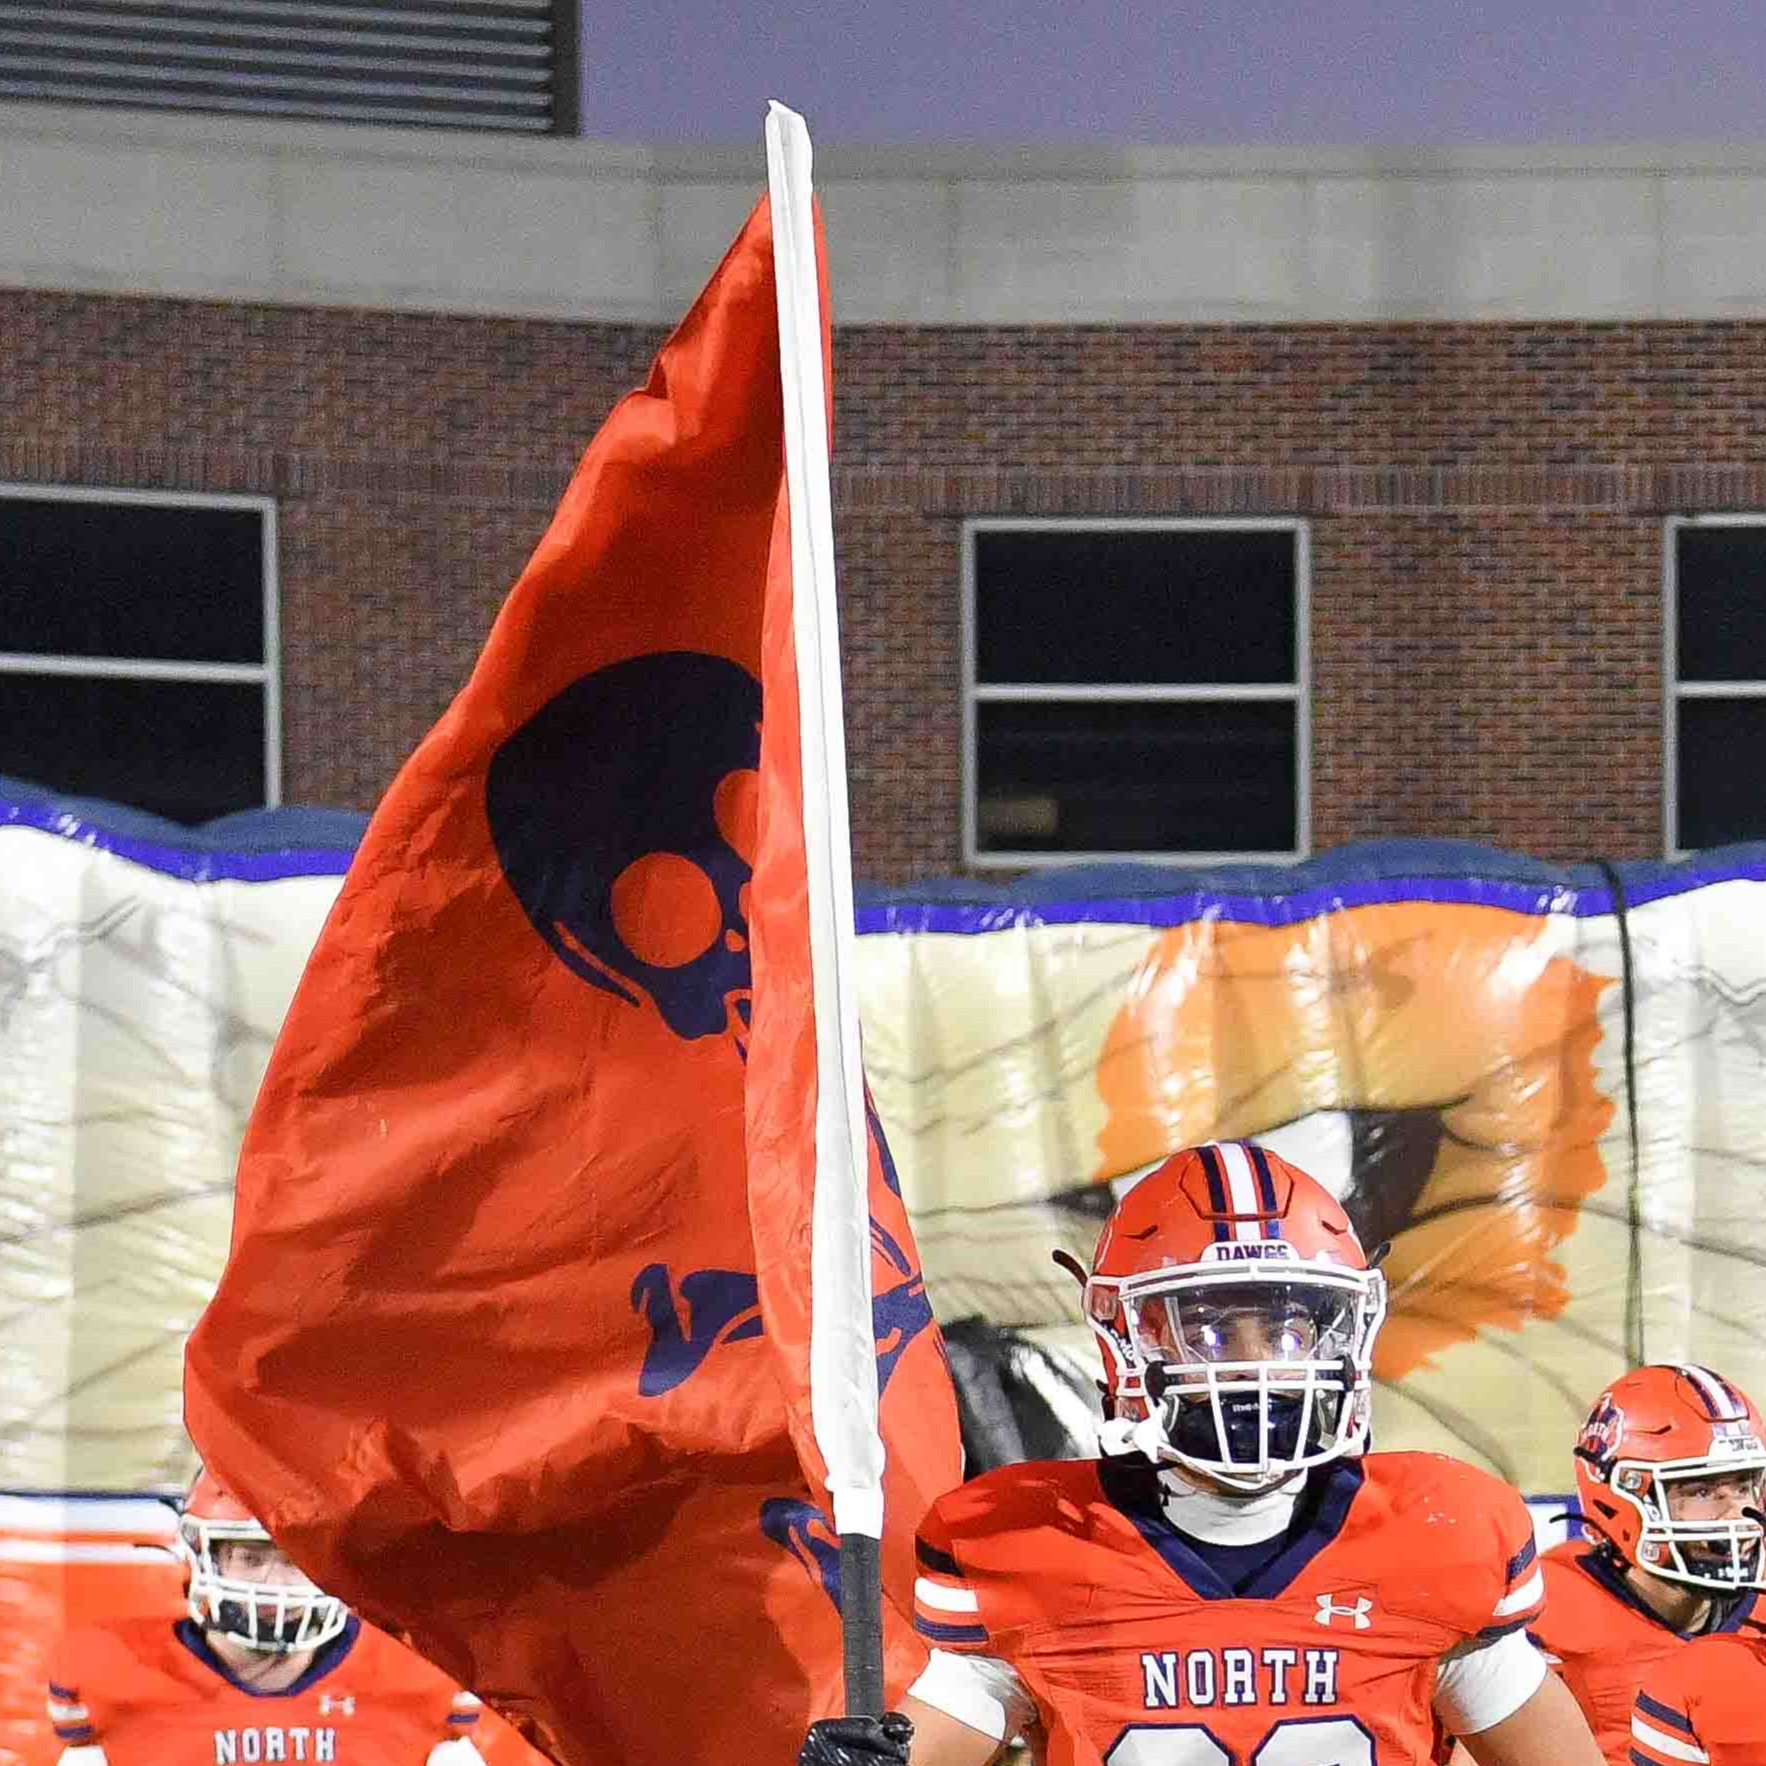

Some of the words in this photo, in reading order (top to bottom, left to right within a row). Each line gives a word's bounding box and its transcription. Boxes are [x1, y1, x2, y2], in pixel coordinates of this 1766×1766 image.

[1216, 1244, 1290, 1261] DAWGS
[1140, 1647, 1339, 1709] NORTH
[213, 1726, 336, 1766] NORTH
